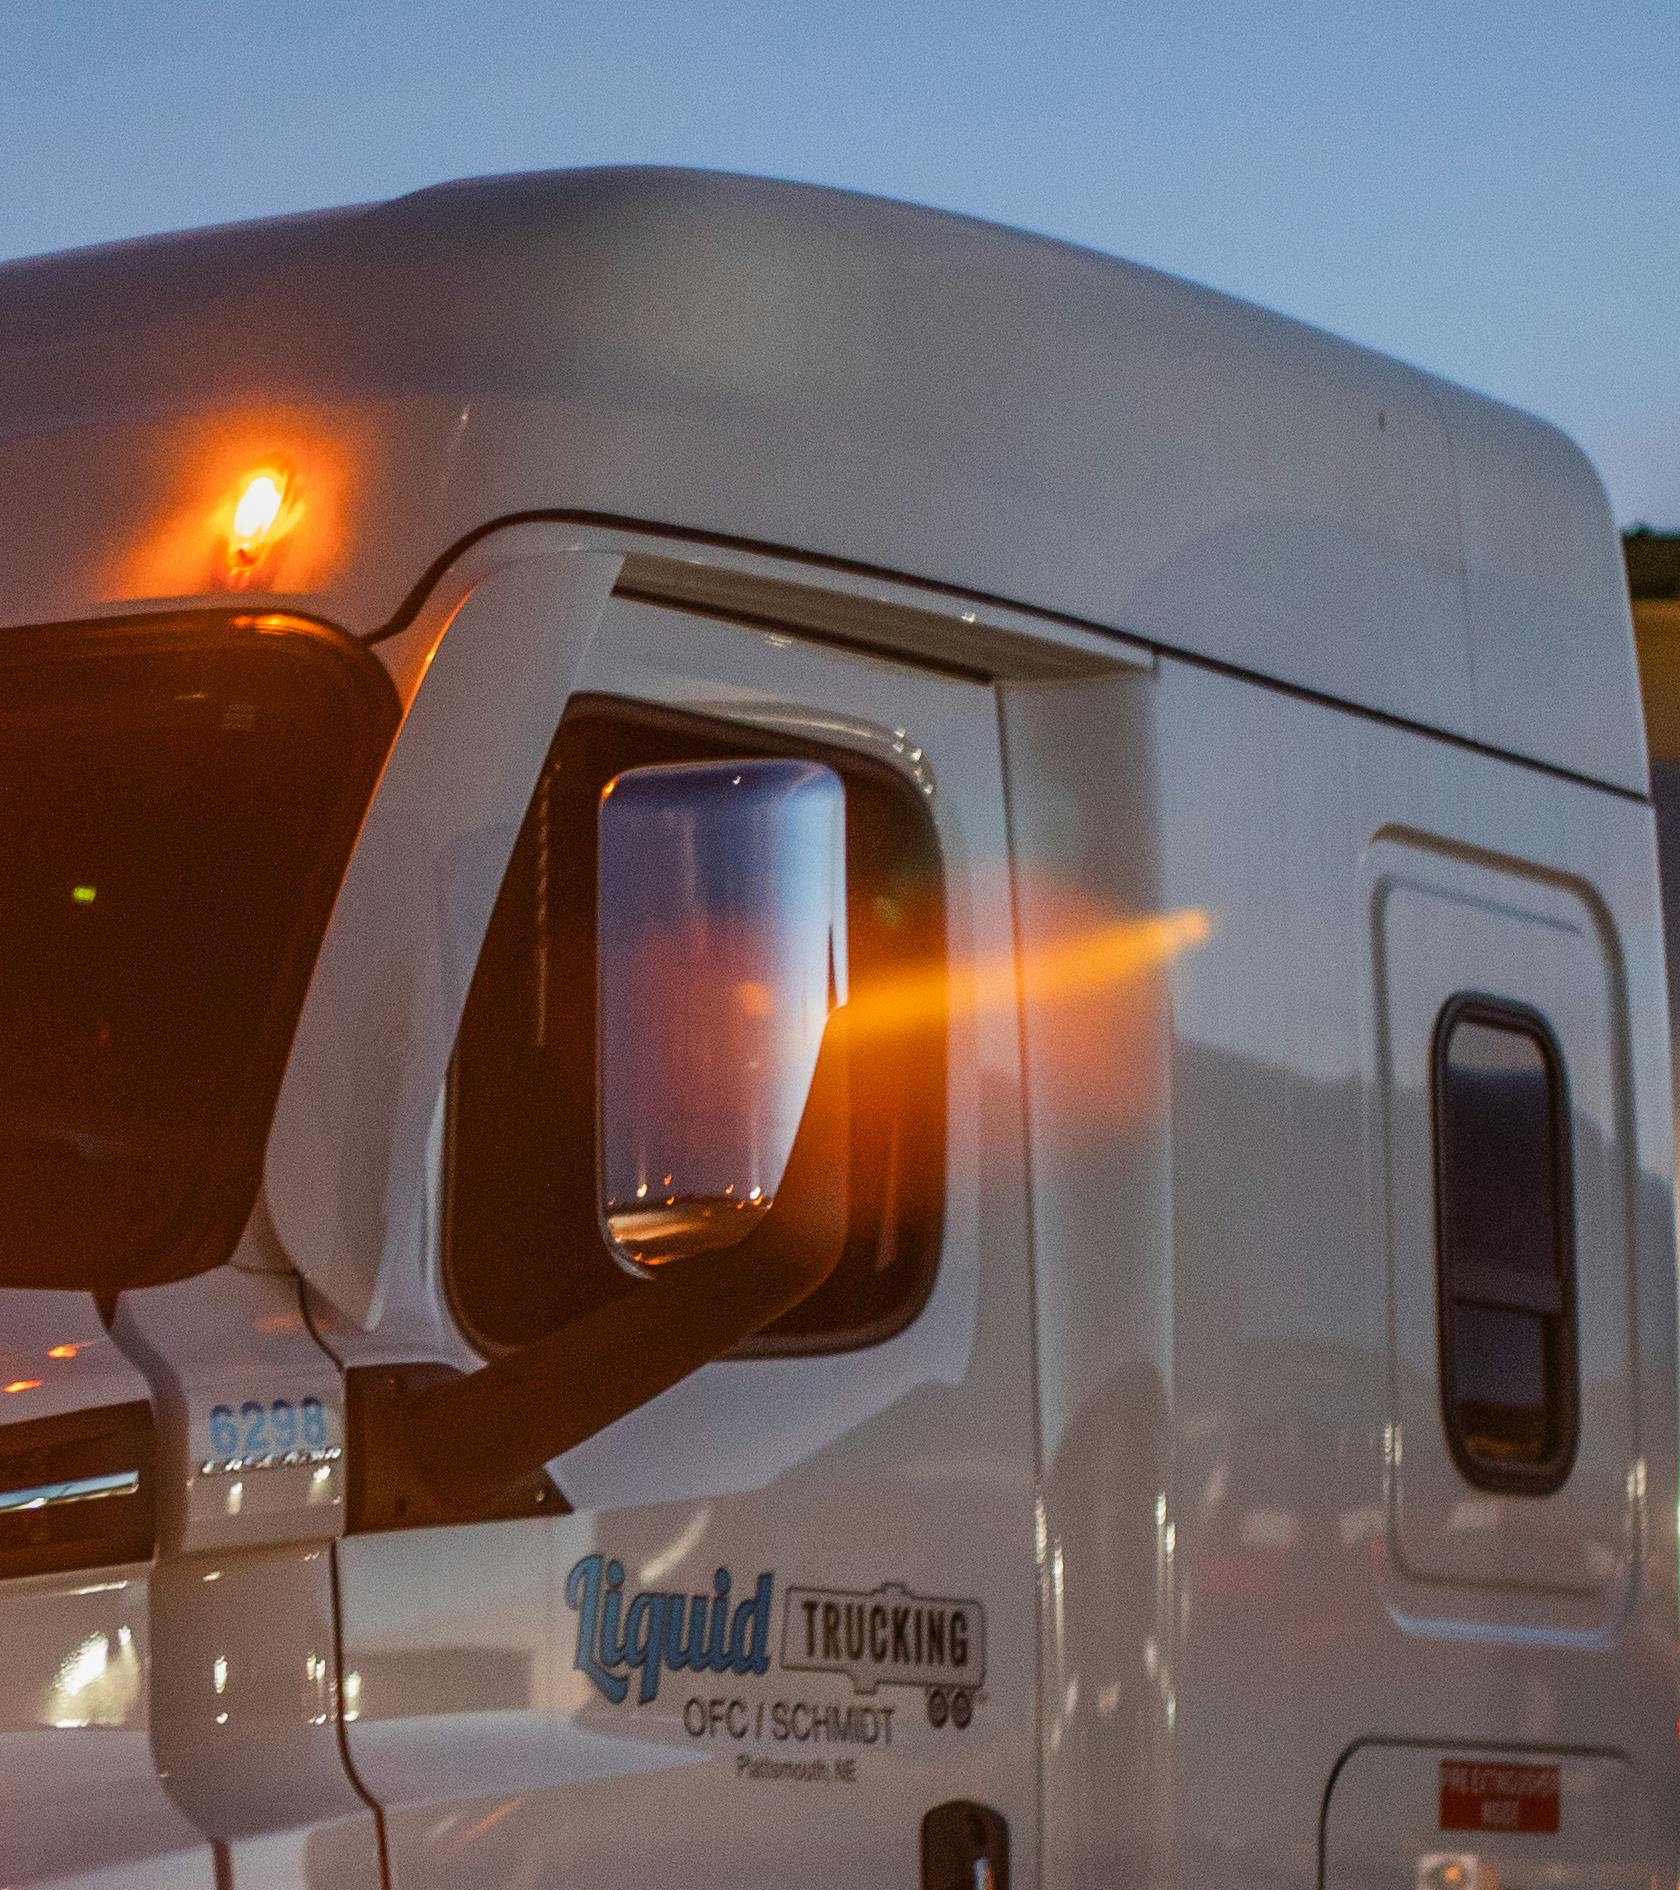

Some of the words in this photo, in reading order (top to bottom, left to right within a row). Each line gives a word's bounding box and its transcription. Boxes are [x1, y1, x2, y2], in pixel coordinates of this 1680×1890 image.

[210, 1397, 327, 1454] 6298
[565, 1553, 774, 1706] Liquid
[801, 1600, 969, 1668] TRUCKING
[682, 1698, 748, 1739] OFC
[771, 1701, 895, 1745] SCHMIDT
